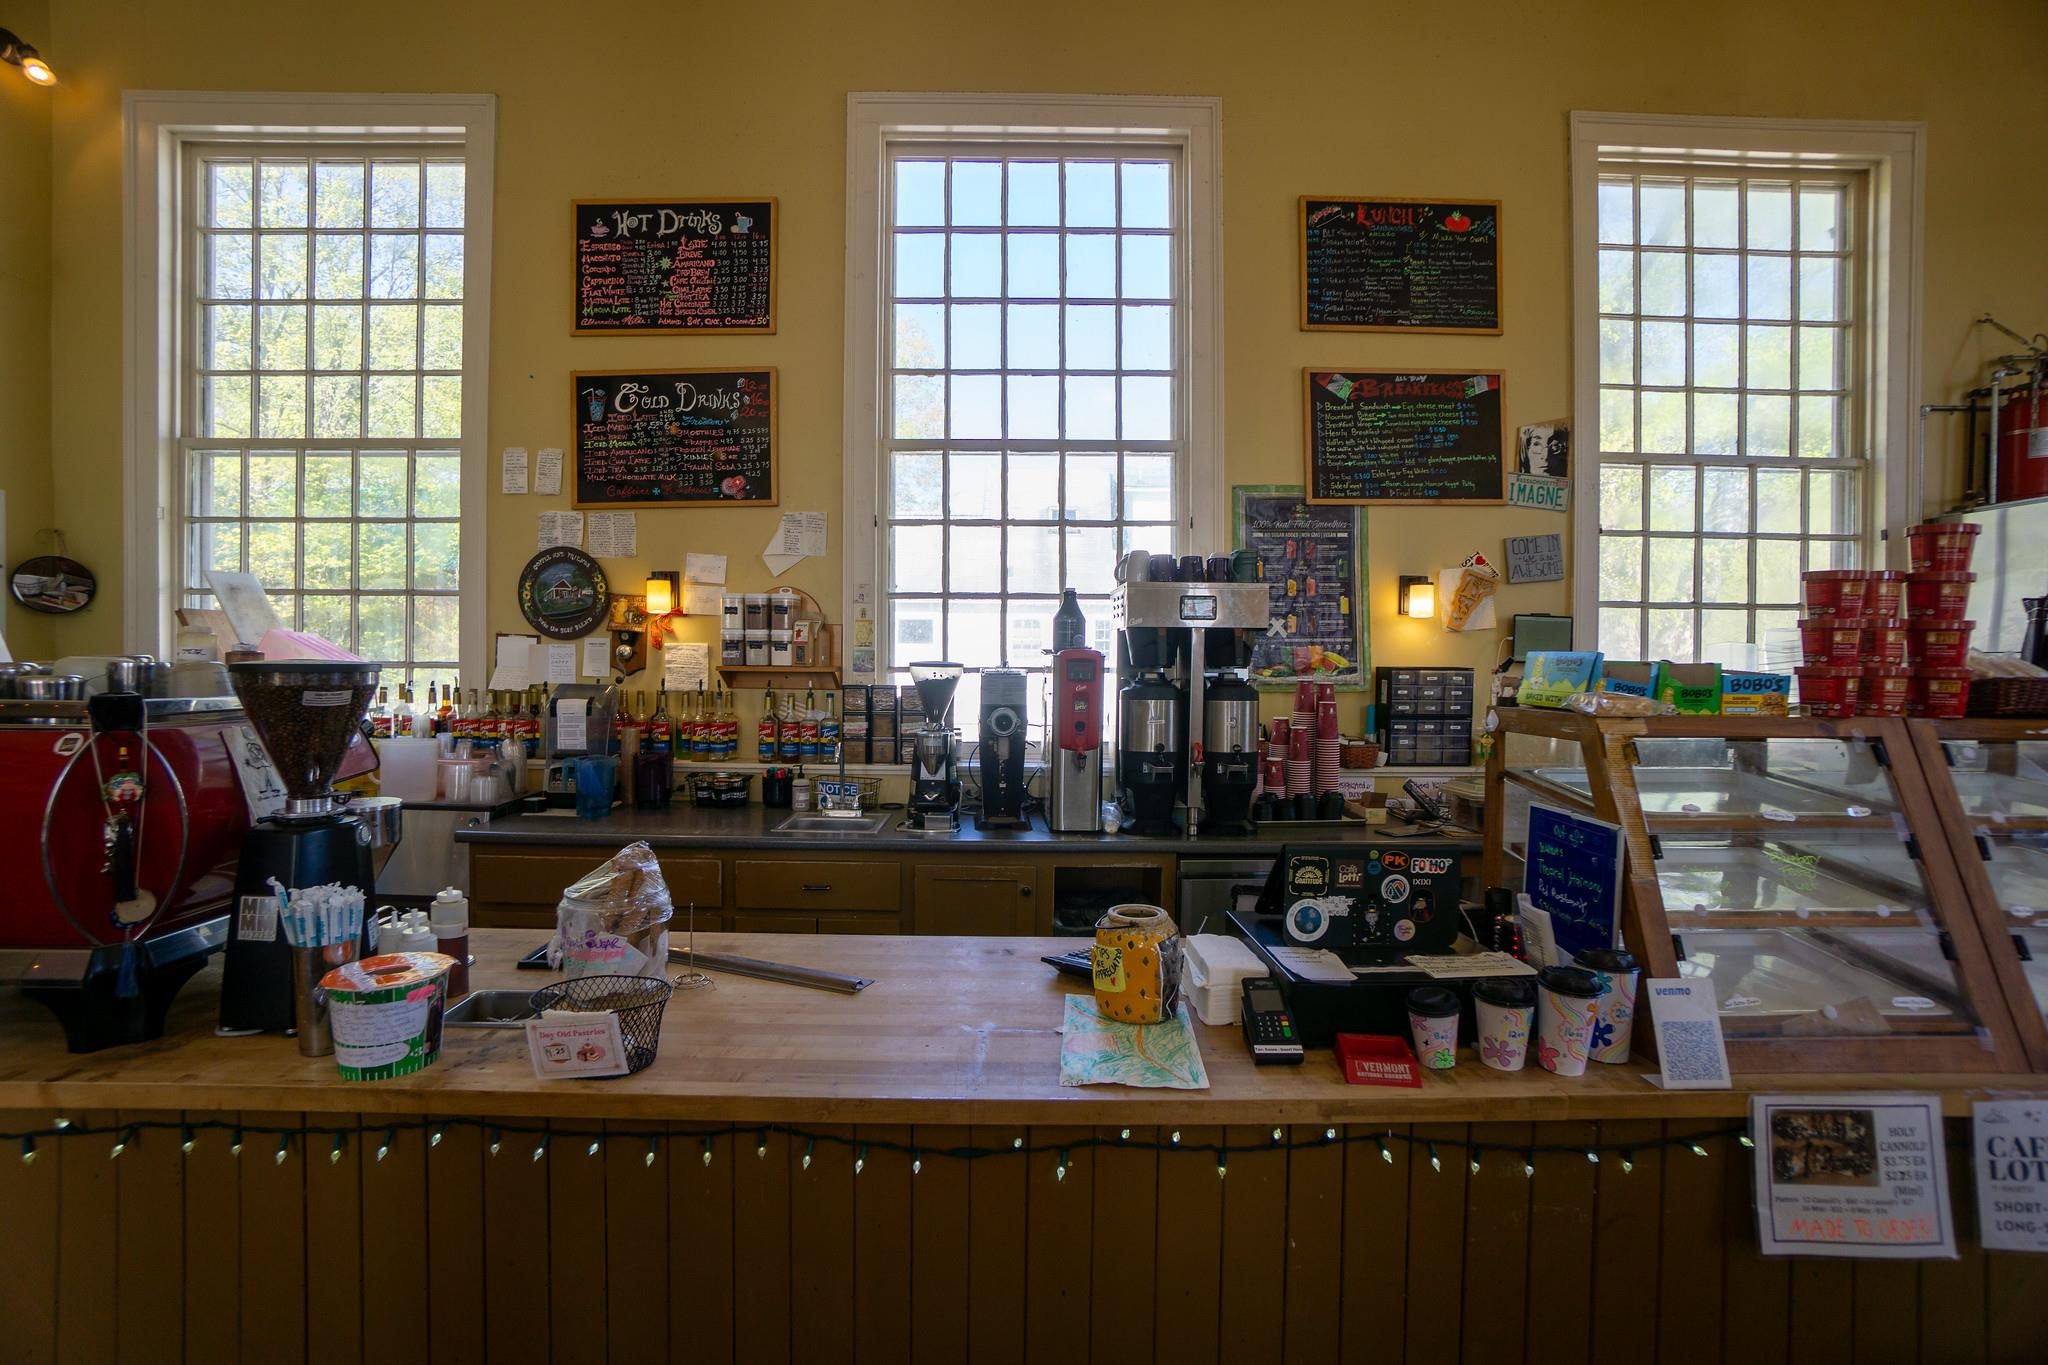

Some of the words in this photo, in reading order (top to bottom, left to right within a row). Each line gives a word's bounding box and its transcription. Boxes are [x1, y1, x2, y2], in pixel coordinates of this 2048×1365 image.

[656, 207, 723, 237] Drinks
[1357, 205, 1414, 229] LUNCH
[615, 382, 669, 413] COLD
[675, 382, 741, 413] DRINKS
[1508, 482, 1566, 507] IMAGNE
[1511, 537, 1542, 556] COME
[1547, 534, 1561, 553] IN
[1731, 678, 1784, 693] BOBO'S
[819, 781, 859, 797] NOTCE
[1384, 855, 1406, 866] PK
[1655, 987, 1692, 997] venmo
[540, 1032, 554, 1042] Day
[556, 1030, 570, 1039] Old
[573, 1028, 606, 1038] Pastries
[1362, 1062, 1411, 1074] VERMONT
[1888, 1127, 1917, 1138] HOLY
[1790, 1217, 1846, 1241] MADE
[1854, 1217, 1873, 1240] TO
